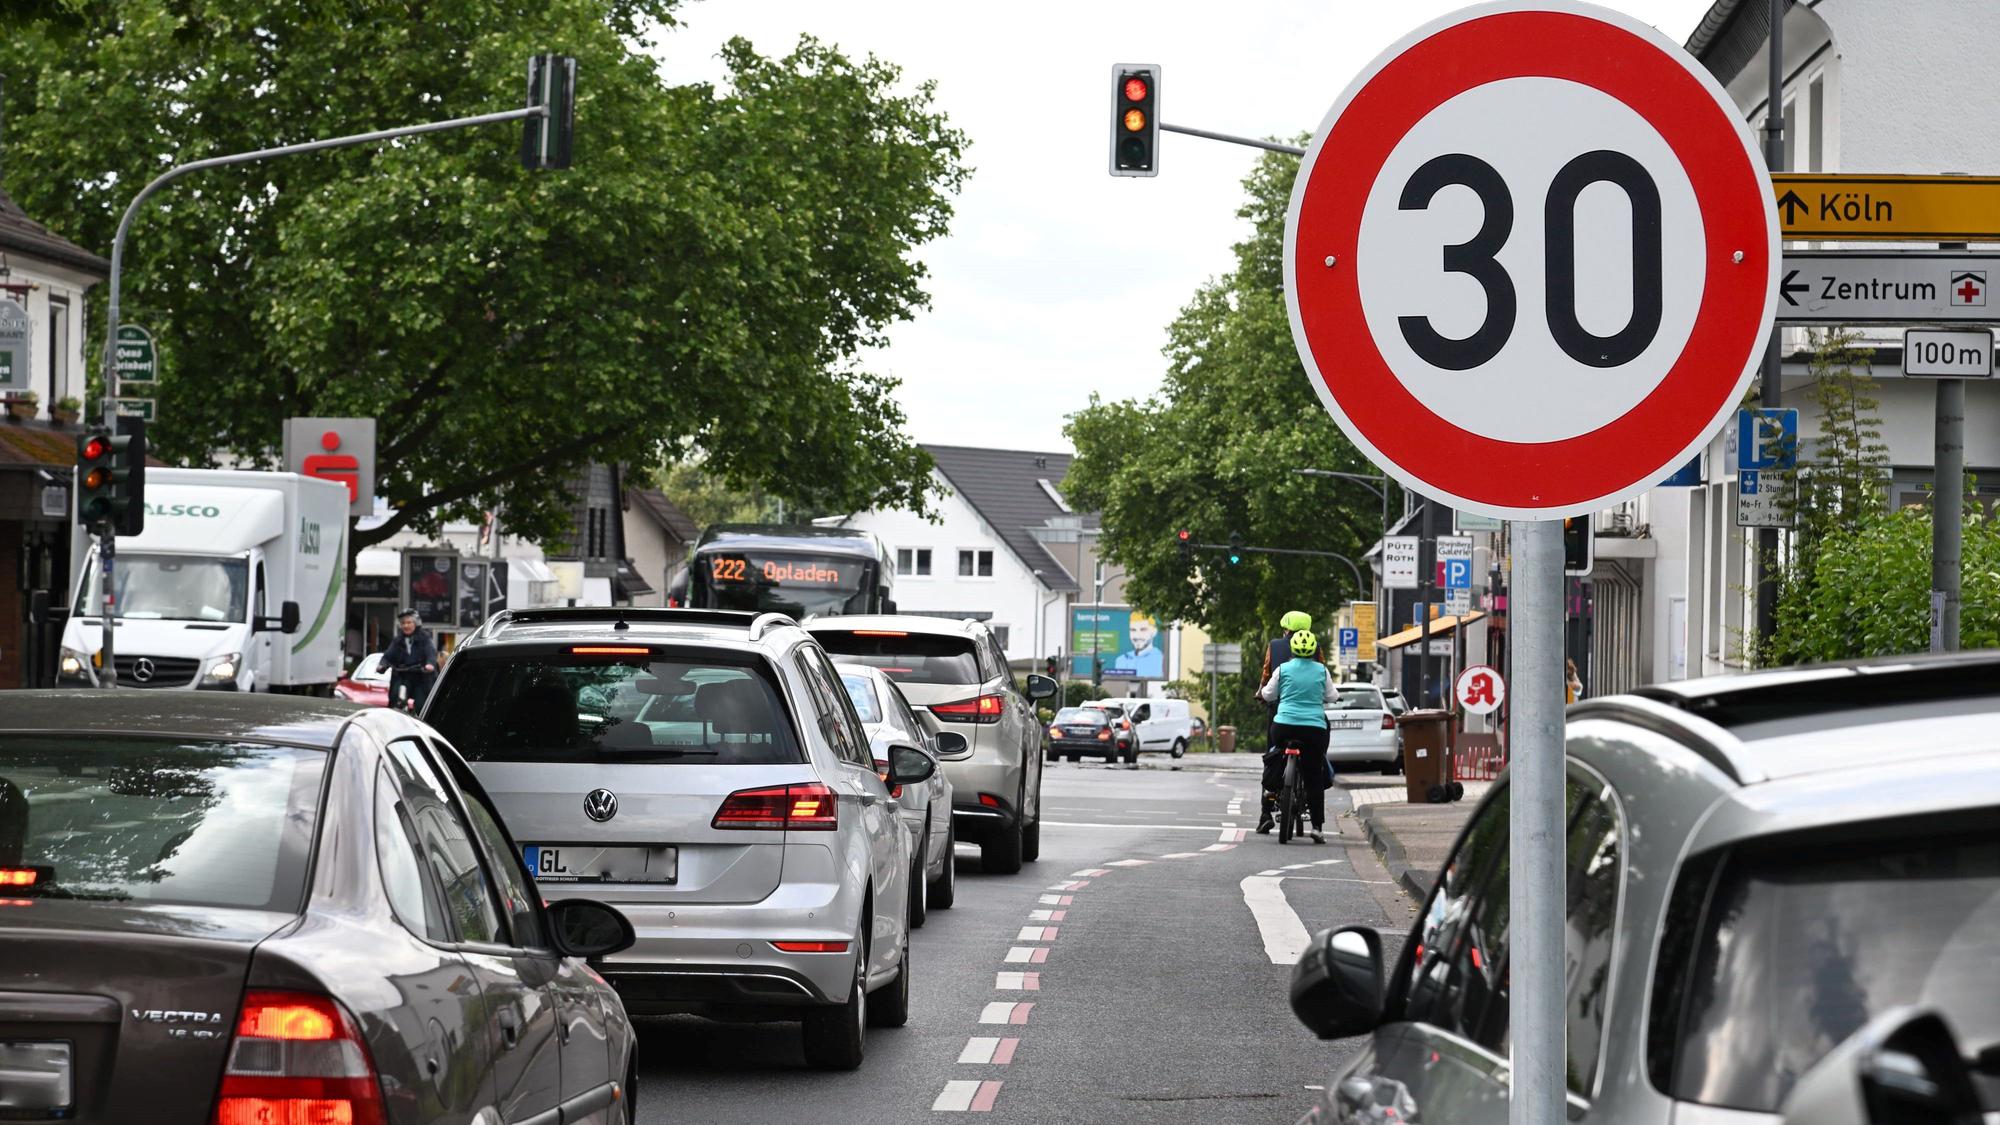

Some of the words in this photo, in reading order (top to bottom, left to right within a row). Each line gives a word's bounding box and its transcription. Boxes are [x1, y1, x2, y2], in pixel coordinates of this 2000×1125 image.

[1820, 193, 1892, 221] Köln
[1398, 149, 1662, 371] 30
[1820, 276, 1936, 300] Zentrum
[1740, 500, 1761, 508] Mo-Fr
[1387, 542, 1414, 550] PÜTZ
[1438, 547, 1471, 555] Galerie
[1386, 554, 1414, 562] ROTH
[713, 559, 745, 580] 222
[764, 561, 838, 583] Opladen
[540, 849, 567, 873] GL
[131, 1009, 222, 1023] VECTRA
